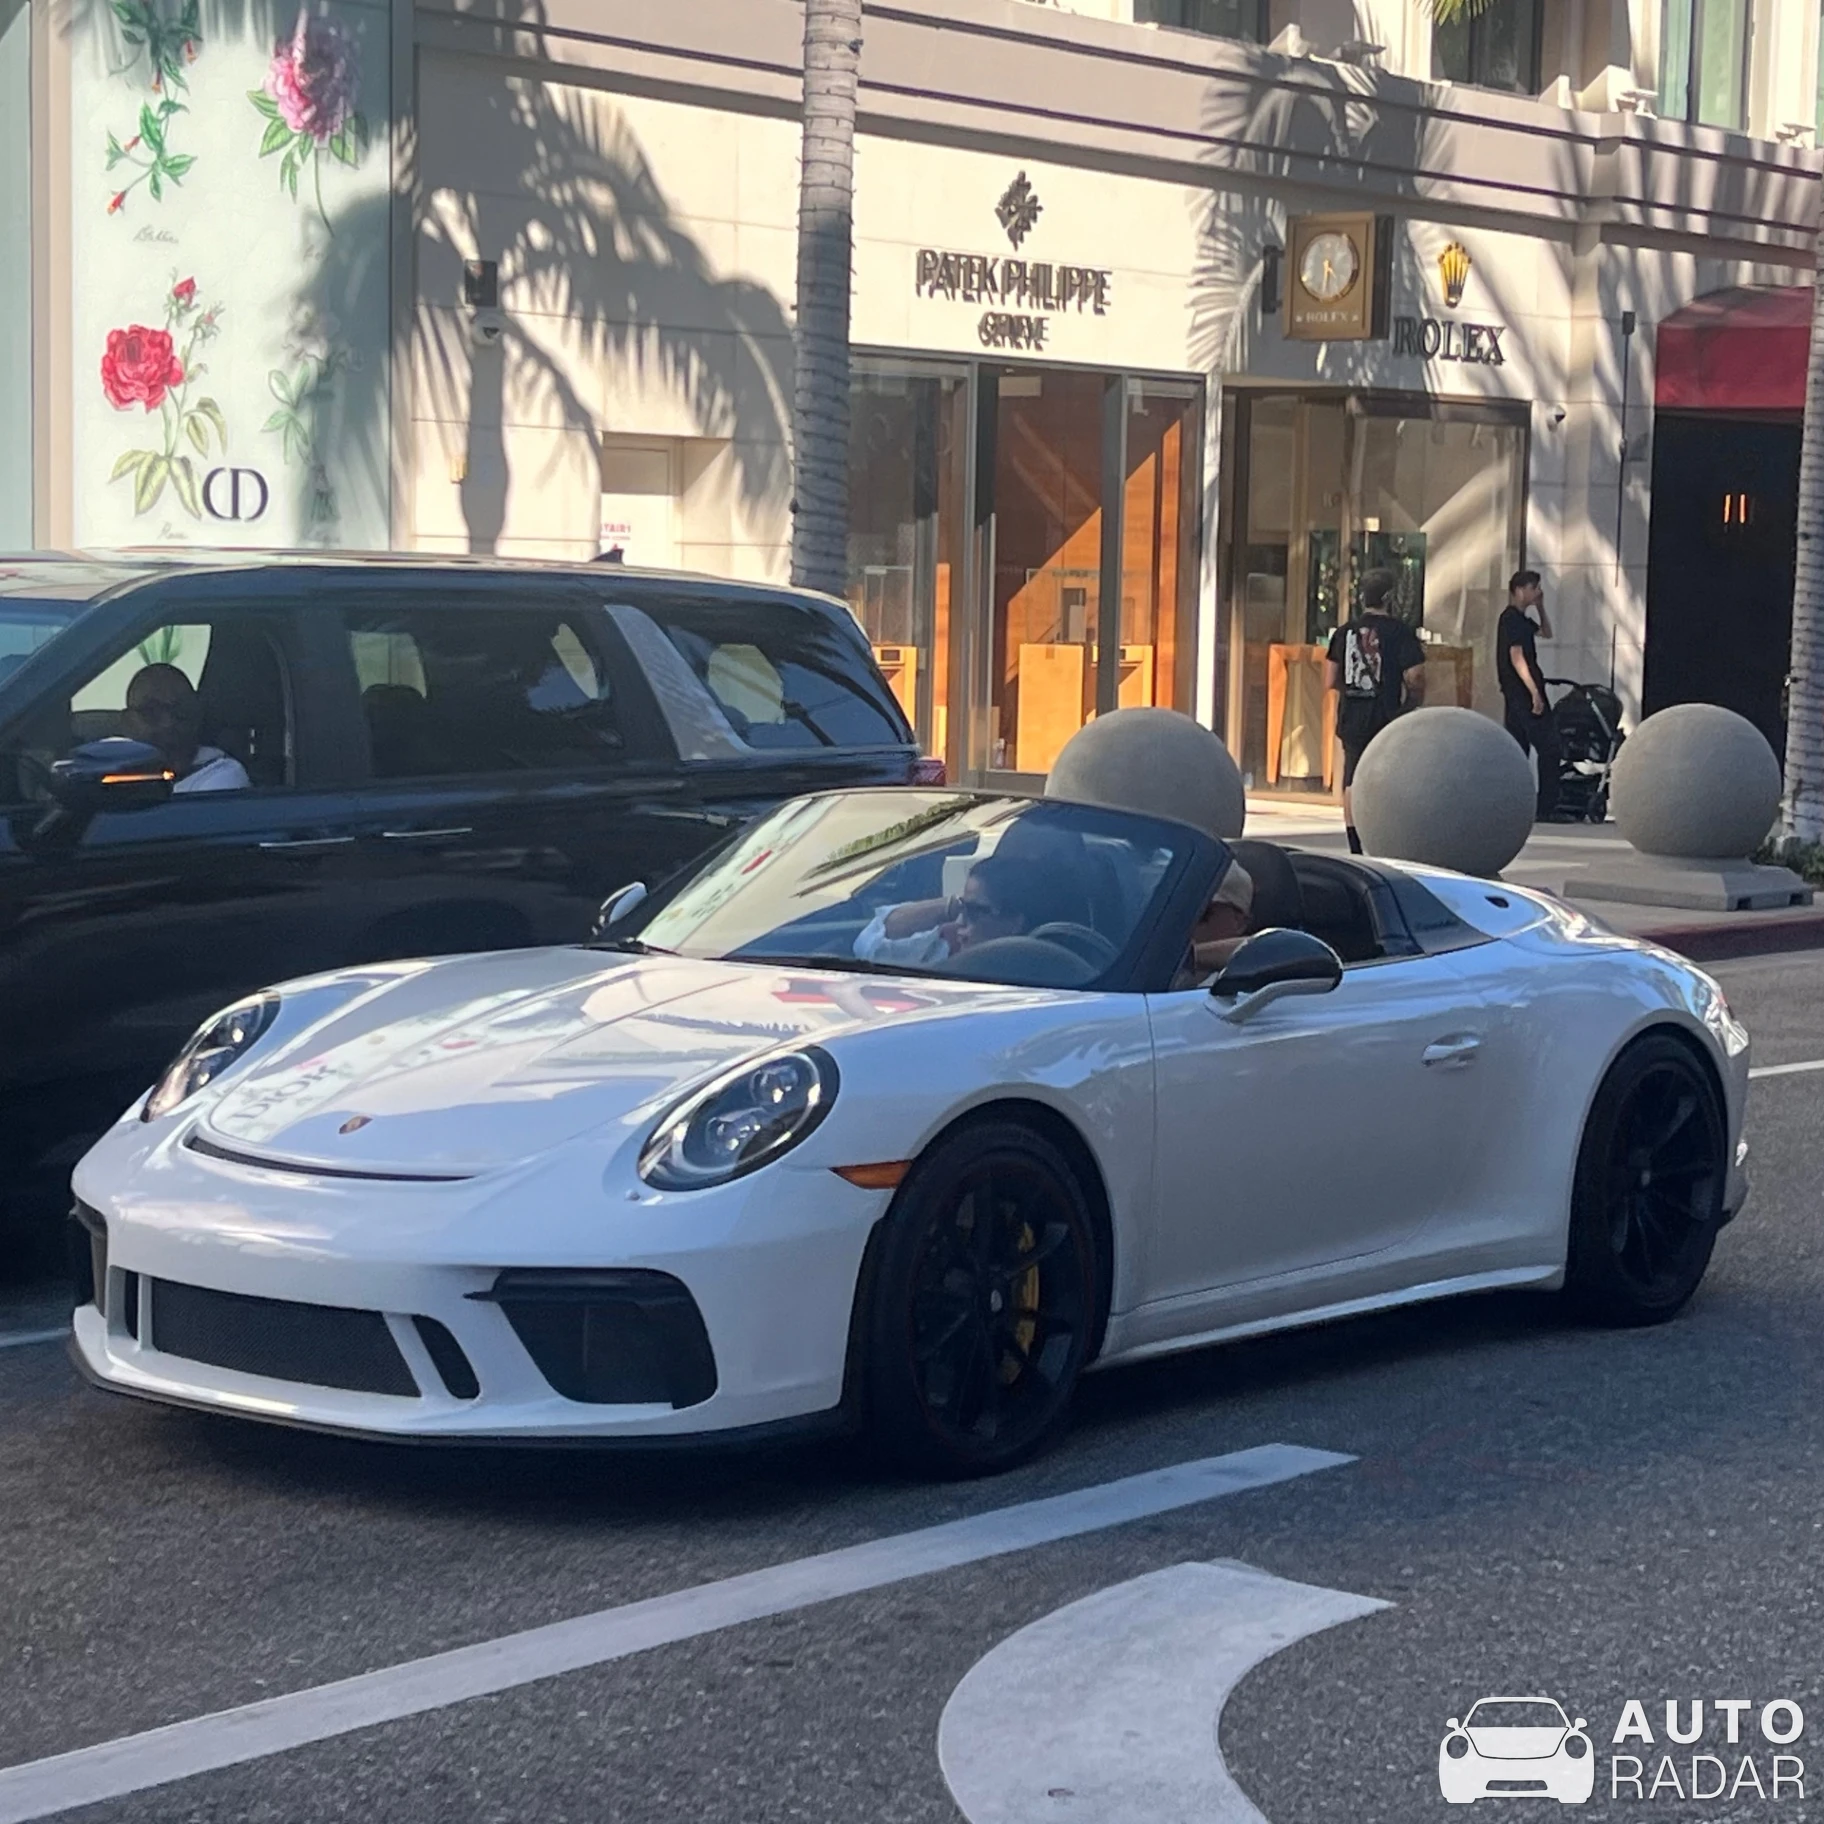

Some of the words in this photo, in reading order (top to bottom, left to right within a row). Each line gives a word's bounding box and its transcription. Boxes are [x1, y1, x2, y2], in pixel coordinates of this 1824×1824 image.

[915, 248, 1000, 304] PATEK
[1001, 257, 1113, 315] PHILIPPE
[1305, 311, 1349, 324] ROLEX
[1391, 315, 1506, 366] ROLEX
